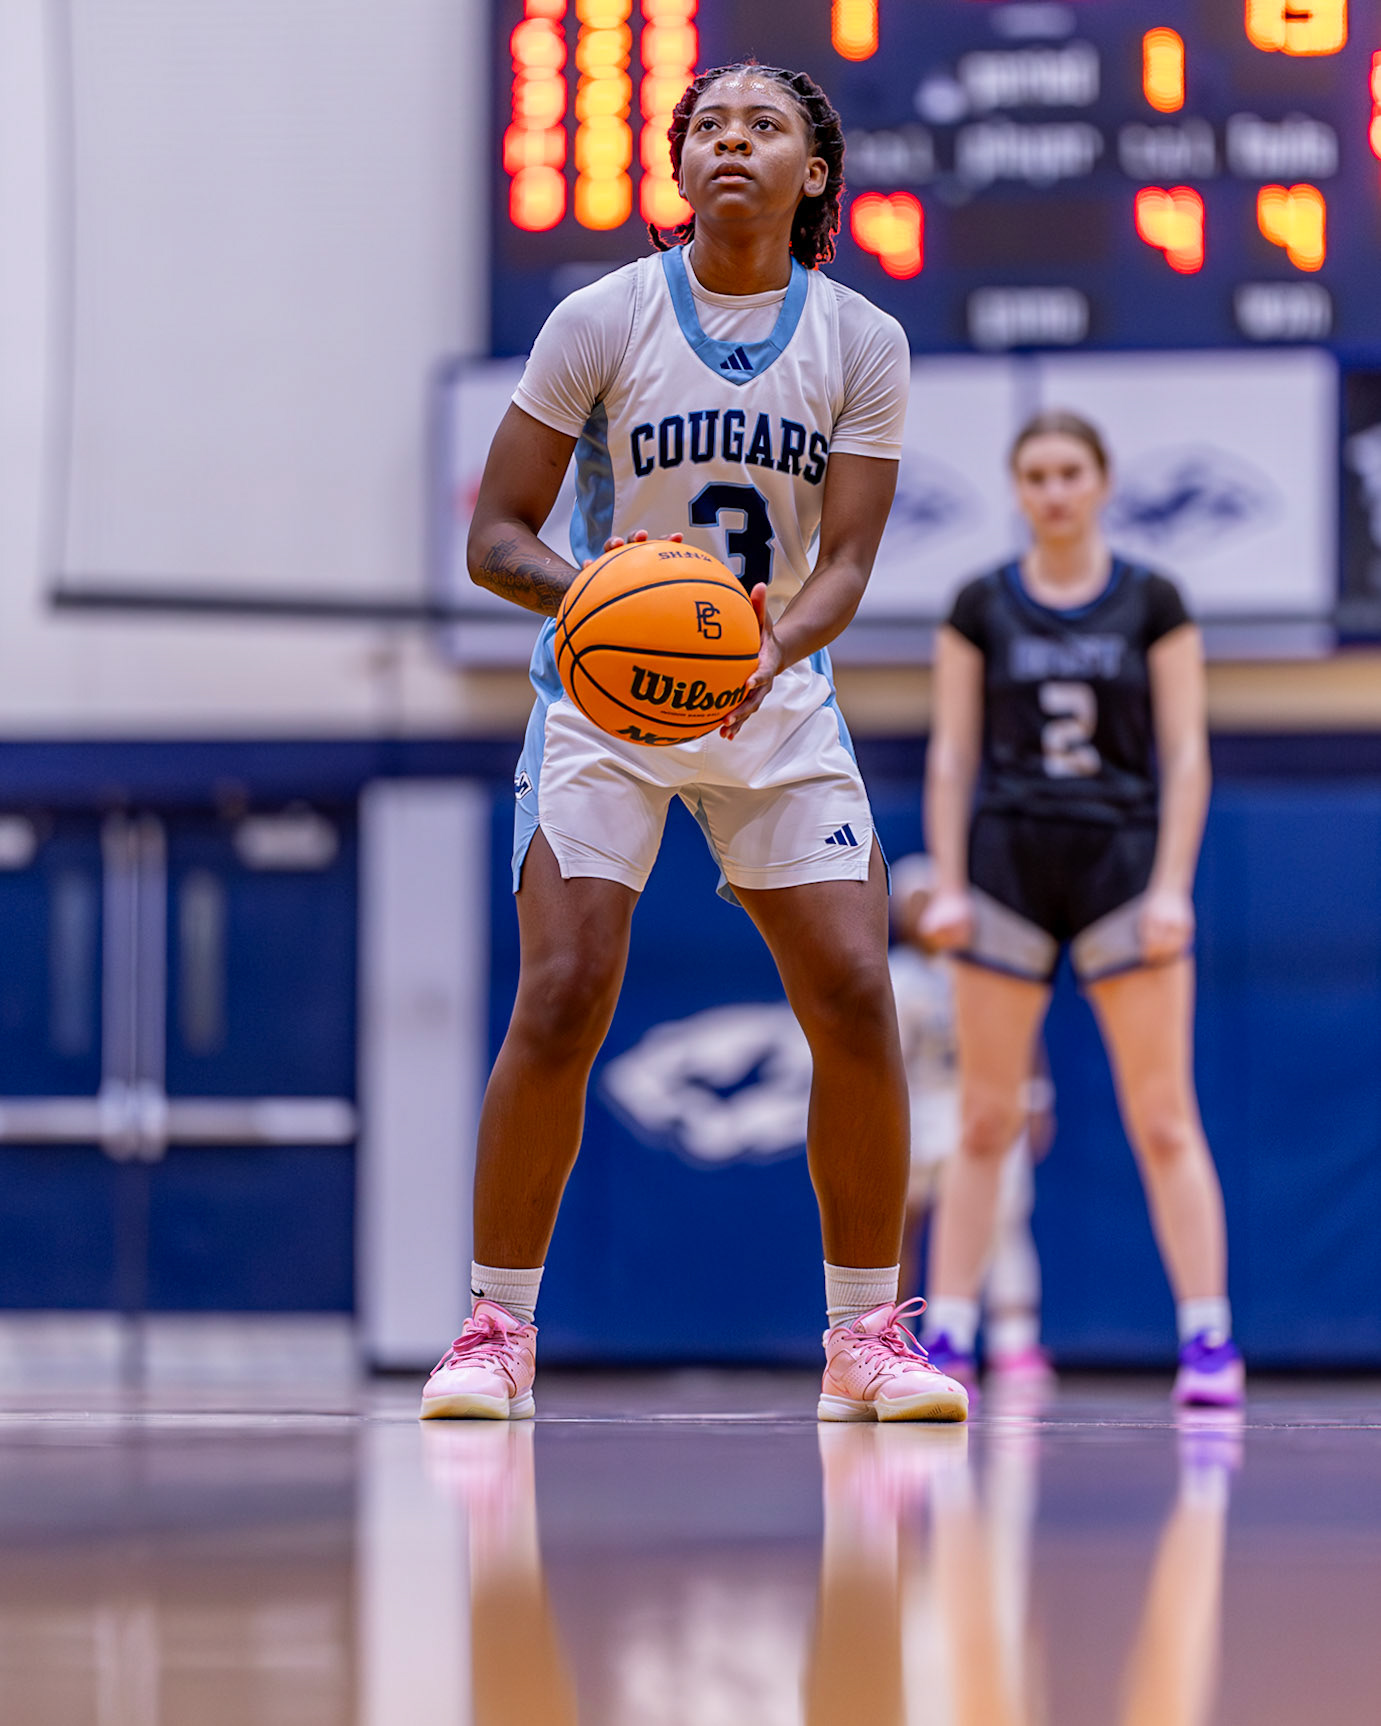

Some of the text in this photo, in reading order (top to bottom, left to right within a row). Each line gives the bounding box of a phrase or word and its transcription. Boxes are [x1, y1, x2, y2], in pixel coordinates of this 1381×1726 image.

[630, 409, 829, 486] COUGARS
[688, 481, 775, 598] 3
[630, 665, 747, 711] Wilson
[1038, 680, 1102, 779] 2
